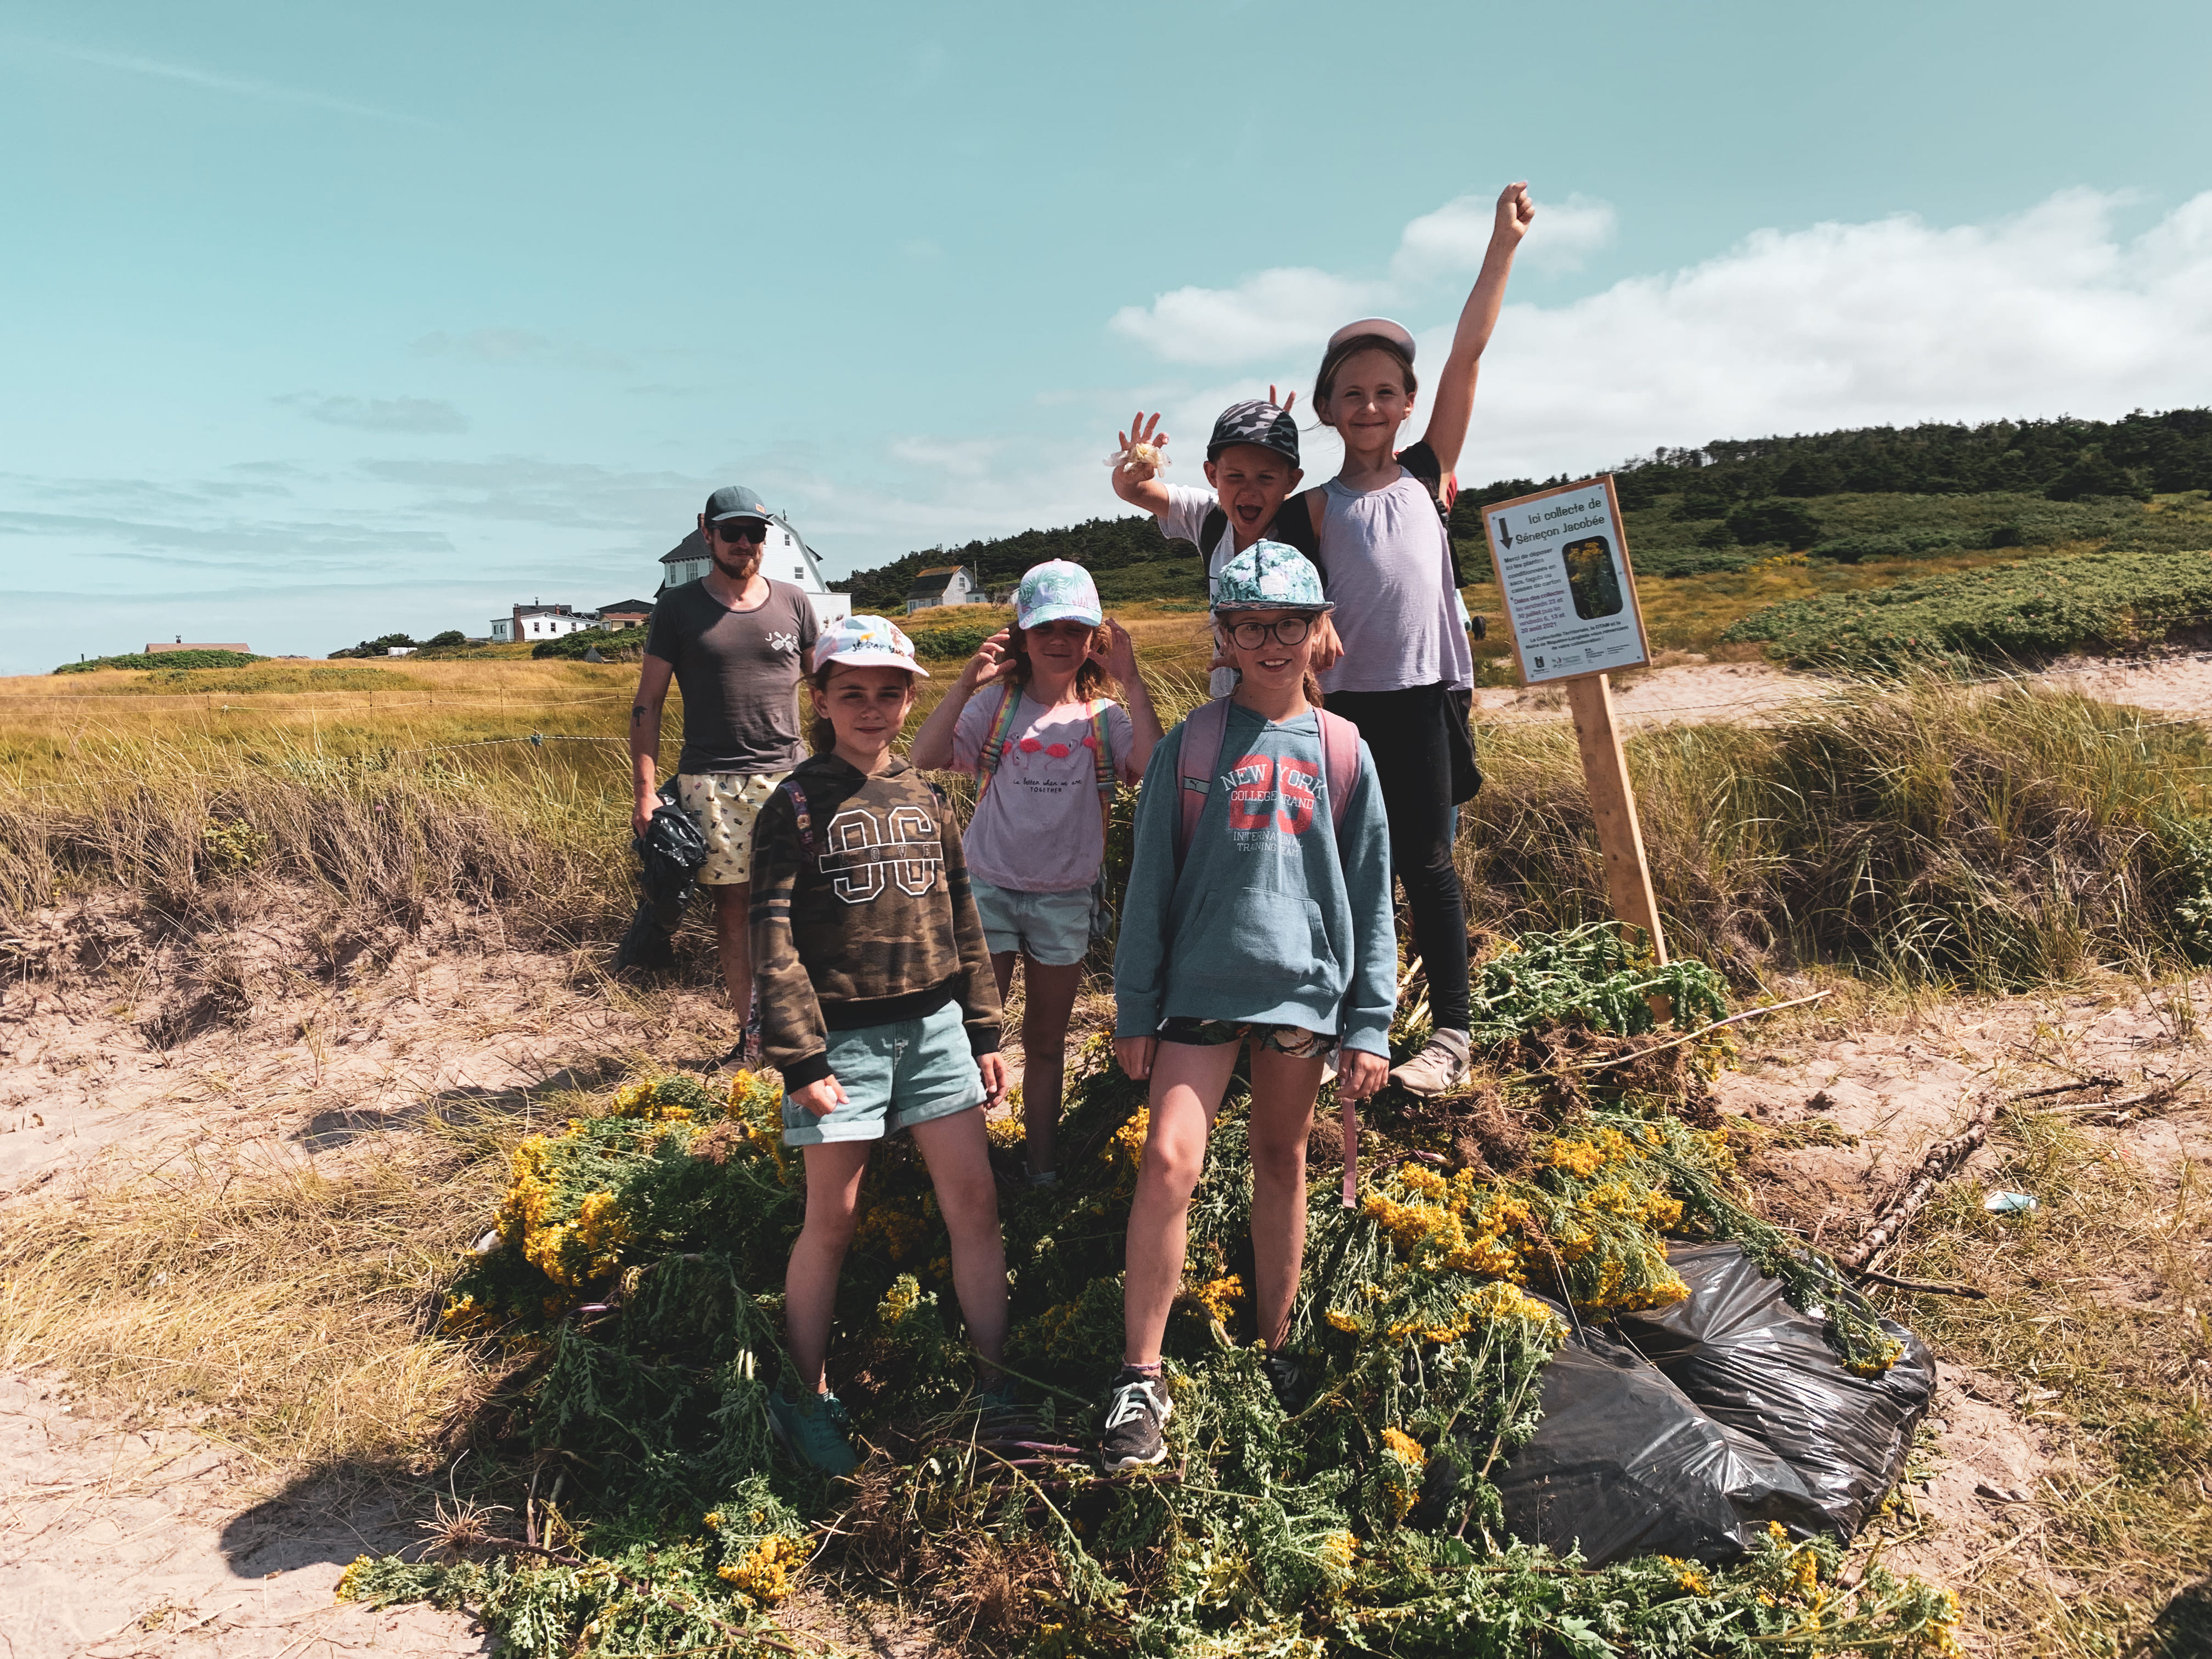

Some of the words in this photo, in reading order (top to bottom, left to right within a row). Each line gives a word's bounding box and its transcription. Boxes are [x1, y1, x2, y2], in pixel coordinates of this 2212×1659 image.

[1528, 513, 1541, 524] Ici
[1544, 504, 1584, 520] collecte
[1589, 498, 1601, 509] de
[1516, 529, 1560, 544] Séneçon
[1563, 515, 1605, 533] Jacobée
[1504, 555, 1520, 563] Merci
[1542, 578, 1561, 586] carton
[765, 632, 772, 641] J
[792, 635, 798, 645] S
[1220, 763, 1267, 791] NEW
[1276, 763, 1327, 800] YORK
[1231, 791, 1277, 802] COLLEGE
[1279, 846, 1300, 857] EAM
